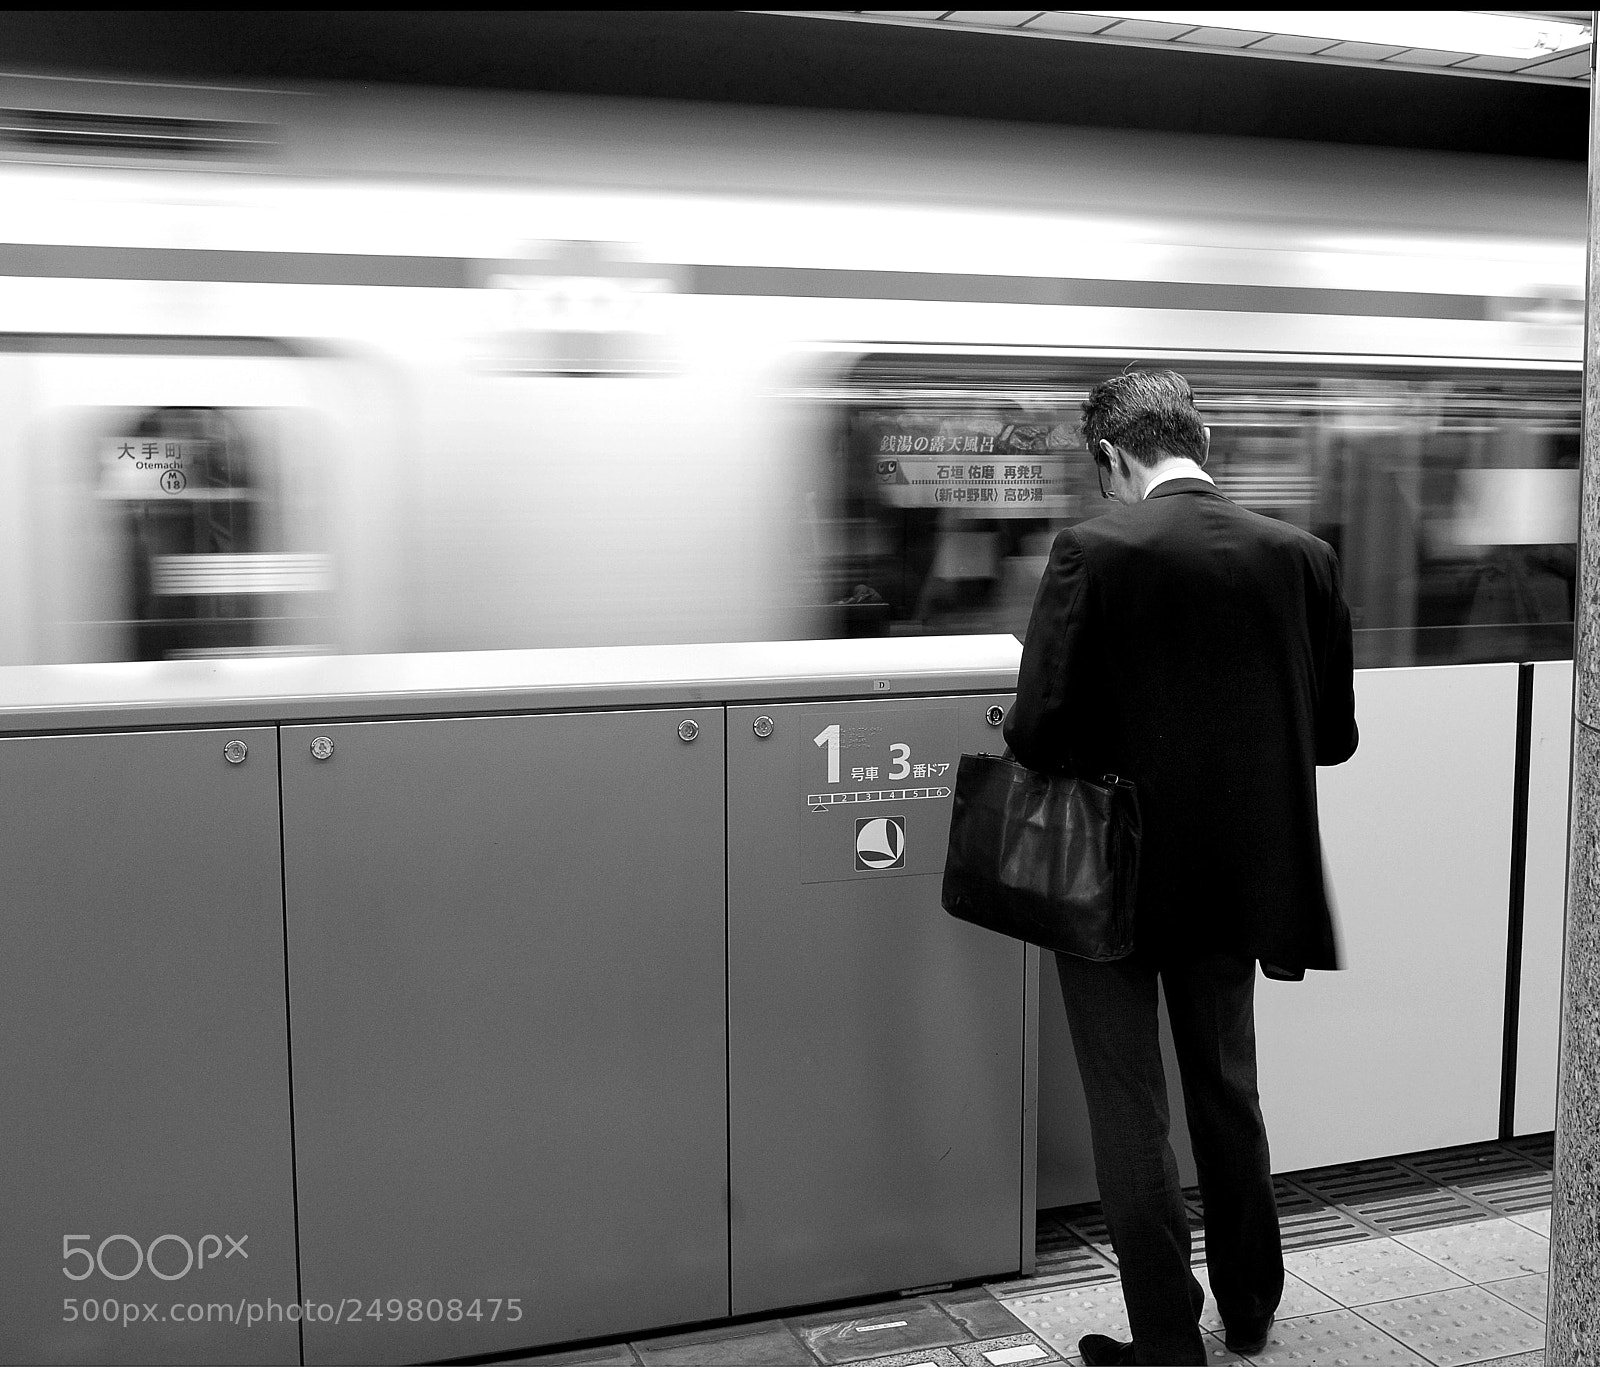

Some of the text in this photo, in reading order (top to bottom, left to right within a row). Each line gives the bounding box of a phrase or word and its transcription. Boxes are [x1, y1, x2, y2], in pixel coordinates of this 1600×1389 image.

[117, 442, 182, 459] 大手町
[135, 461, 184, 470] Otemachi
[1004, 465, 1043, 479] 再発見
[167, 480, 181, 490] 18
[1004, 487, 1043, 502] 高砂湯
[817, 788, 943, 804] 1 2 3 4 5 6
